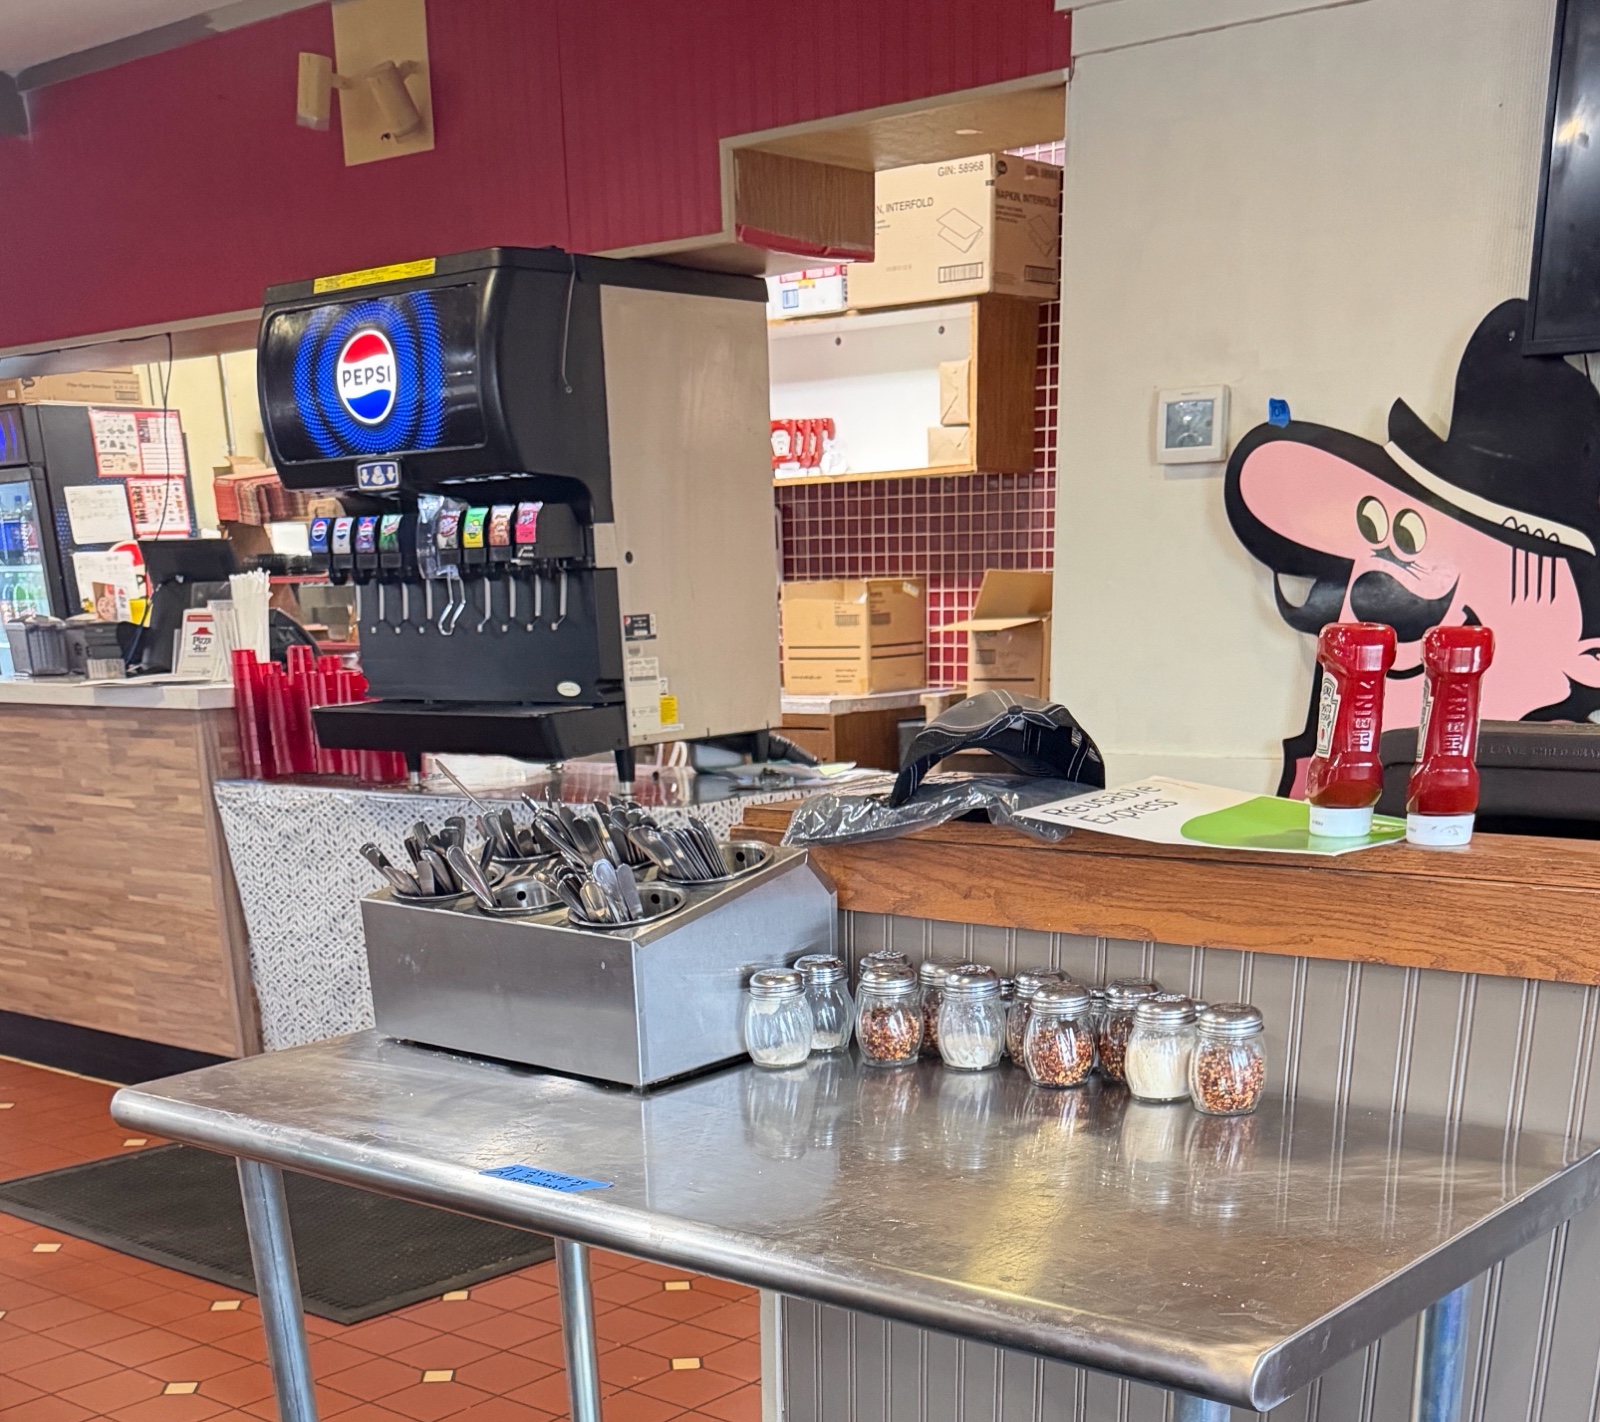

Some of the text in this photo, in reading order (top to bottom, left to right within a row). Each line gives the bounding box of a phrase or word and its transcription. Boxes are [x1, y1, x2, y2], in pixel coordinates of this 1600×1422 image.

[937, 165, 957, 177] GIN:
[958, 160, 984, 174] 58968
[885, 196, 934, 213] INTERFOLD
[342, 364, 391, 388] PEPSI
[1352, 681, 1375, 746] HEINZ
[1443, 683, 1469, 752] HEINZ
[1041, 786, 1162, 817] Reusable
[1078, 798, 1179, 825] Express
